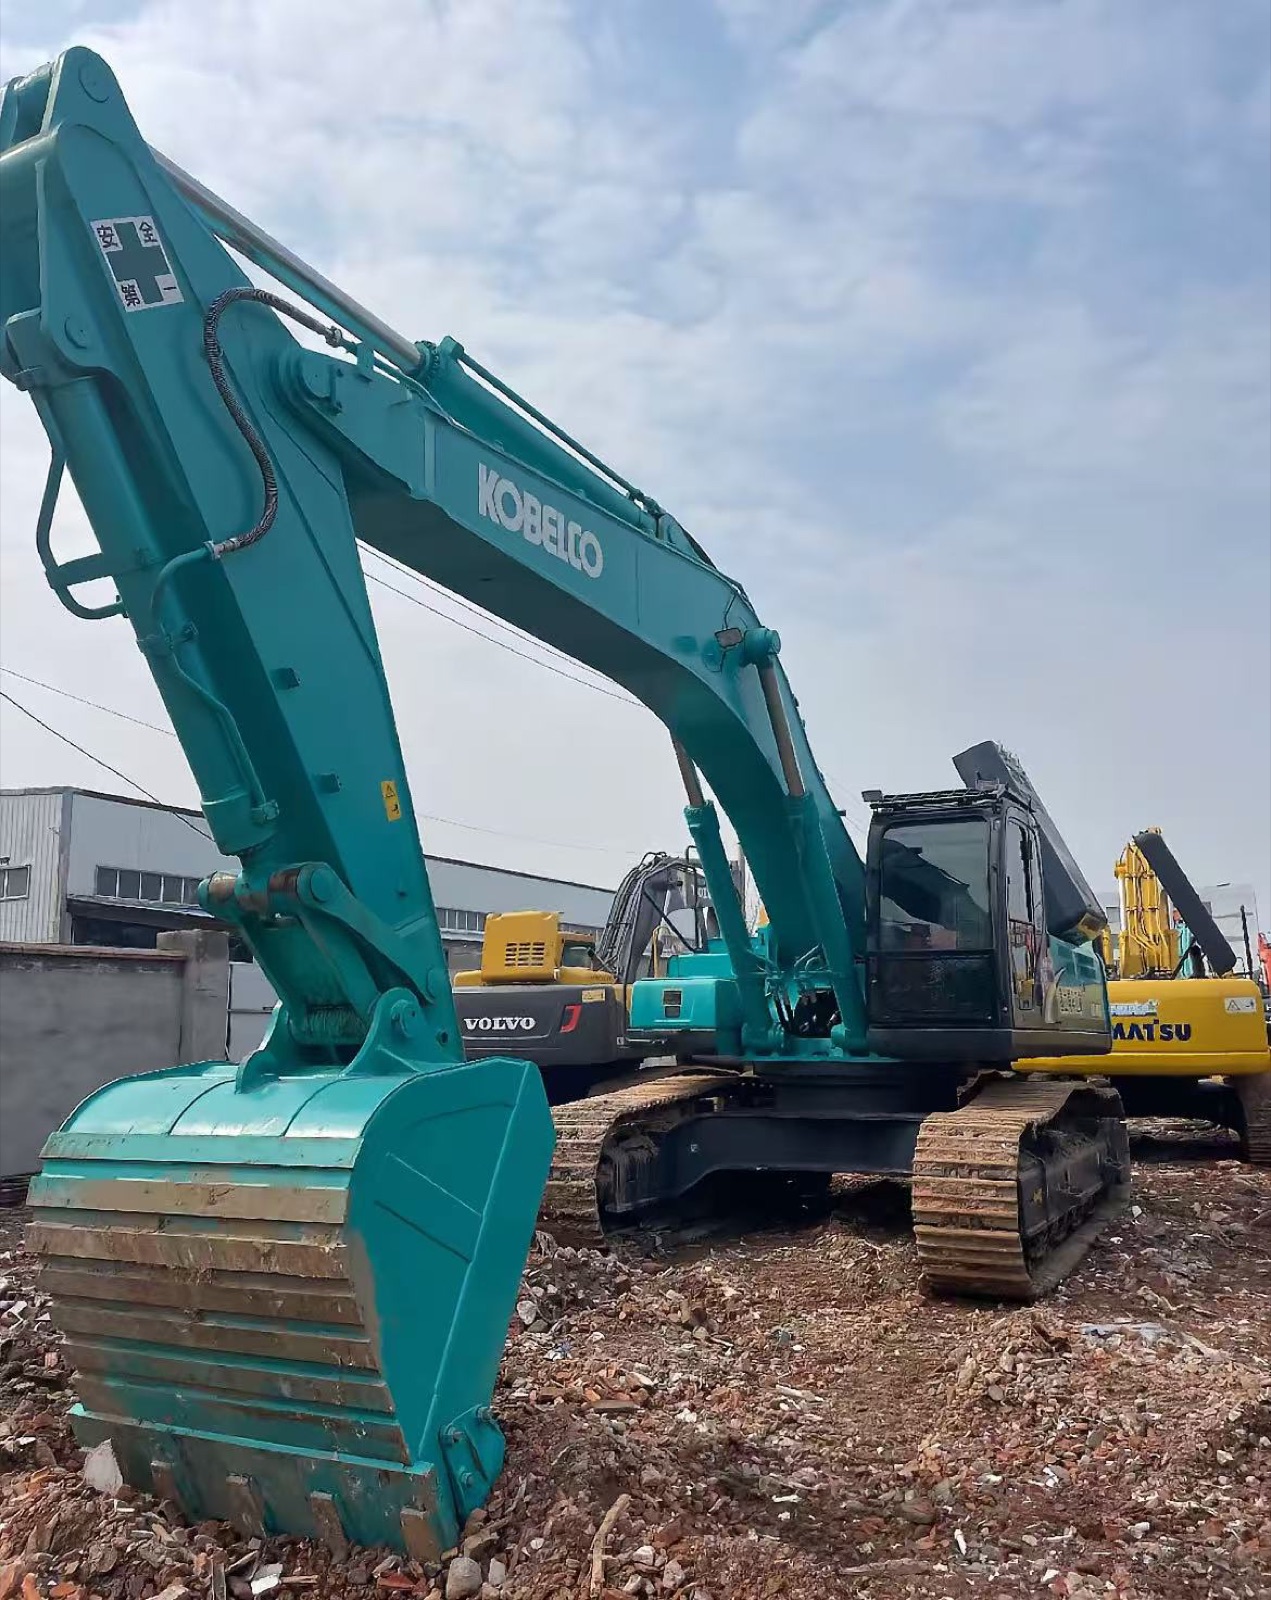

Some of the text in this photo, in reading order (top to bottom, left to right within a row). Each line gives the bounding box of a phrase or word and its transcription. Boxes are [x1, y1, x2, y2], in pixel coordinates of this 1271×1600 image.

[97, 221, 157, 249] 安全
[121, 284, 177, 307] 第一
[478, 462, 604, 579] KOBELCO
[463, 1016, 536, 1031] VOLVO
